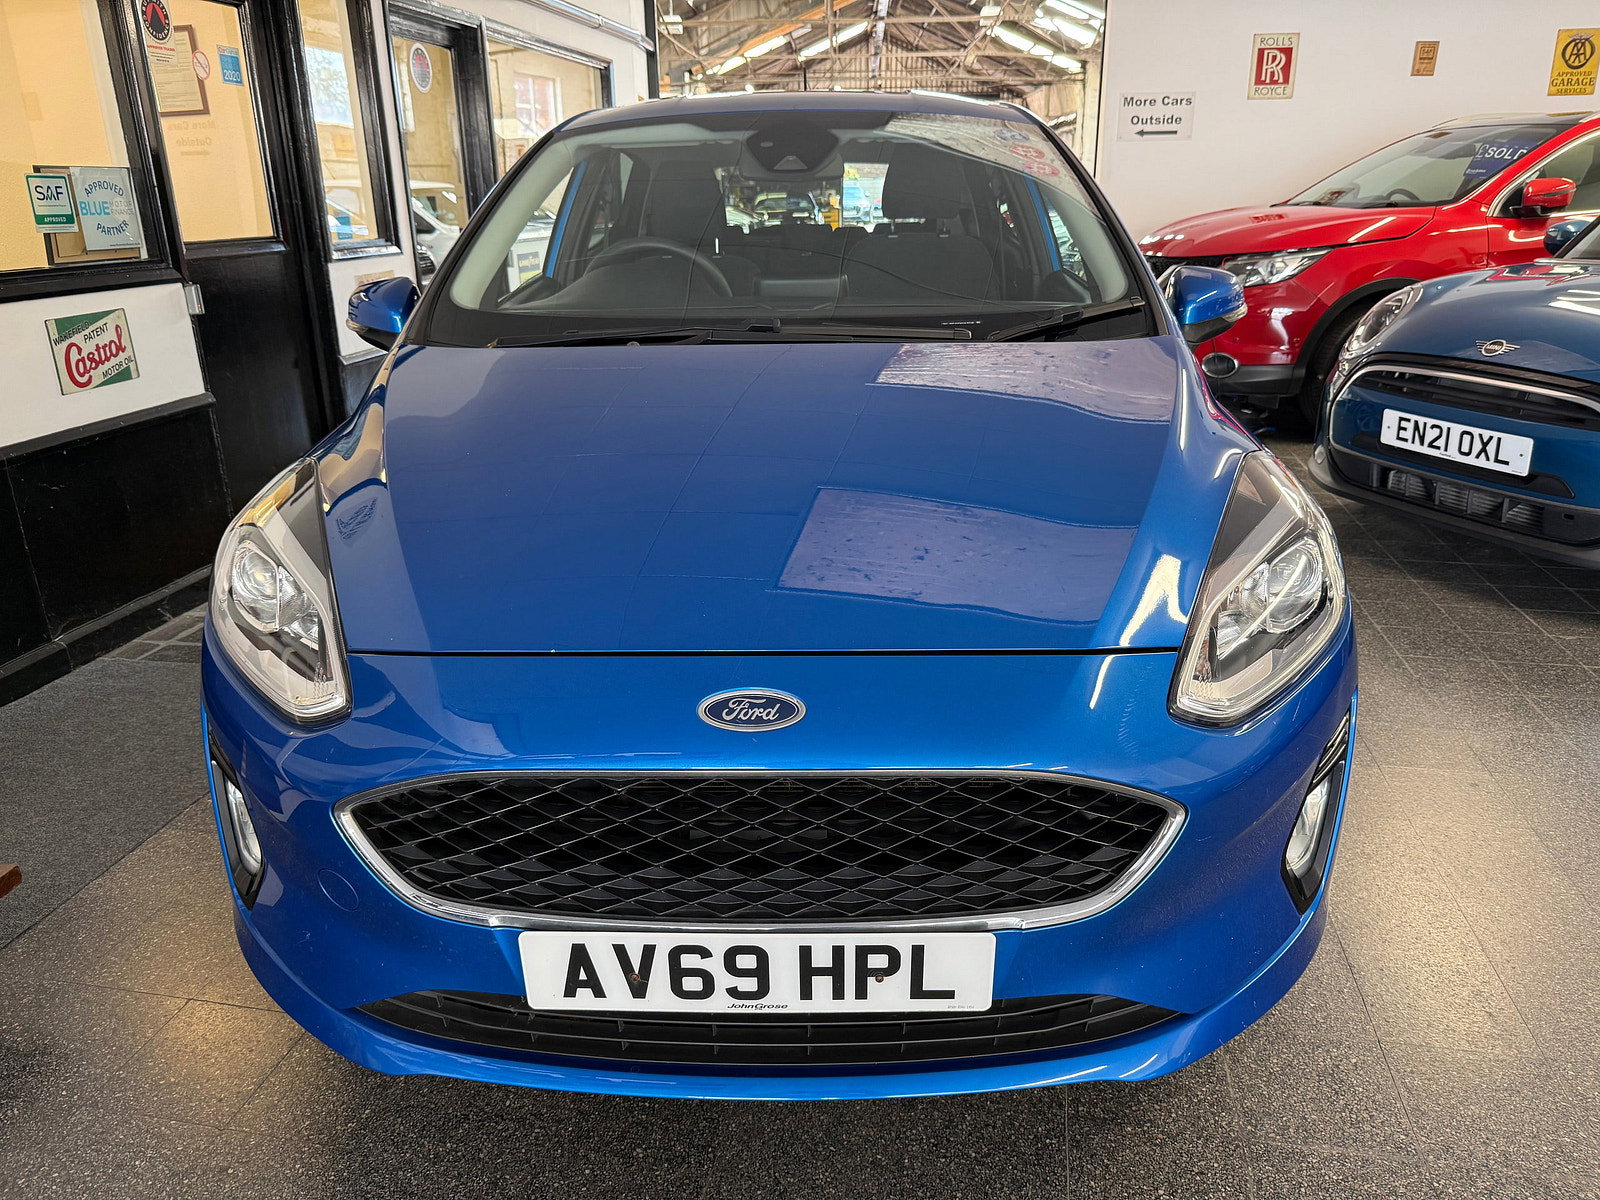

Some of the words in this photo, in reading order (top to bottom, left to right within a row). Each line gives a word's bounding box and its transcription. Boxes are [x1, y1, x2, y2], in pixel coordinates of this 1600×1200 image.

[1260, 37, 1293, 46] ROLLS
[223, 69, 241, 82] 2020
[1551, 77, 1596, 87] GARAGE
[1254, 86, 1288, 96] ROYCE
[1123, 97, 1156, 107] More
[1162, 95, 1192, 106] Cars
[1131, 114, 1182, 125] Outside
[35, 185, 63, 201] SAF
[84, 180, 124, 197] APPROVED
[79, 200, 111, 216] BLUE
[97, 219, 129, 237] PARTNER
[53, 321, 90, 347] WAKEFIELD
[83, 322, 109, 344] PATENT
[64, 324, 127, 389] Castrol
[102, 361, 124, 379] MOTOR
[122, 355, 134, 366] OIL
[1395, 416, 1451, 453] EN21
[1457, 430, 1510, 466] OXL
[721, 698, 781, 721] Ford
[563, 943, 770, 1000] AV69
[799, 944, 956, 1000] HPL
